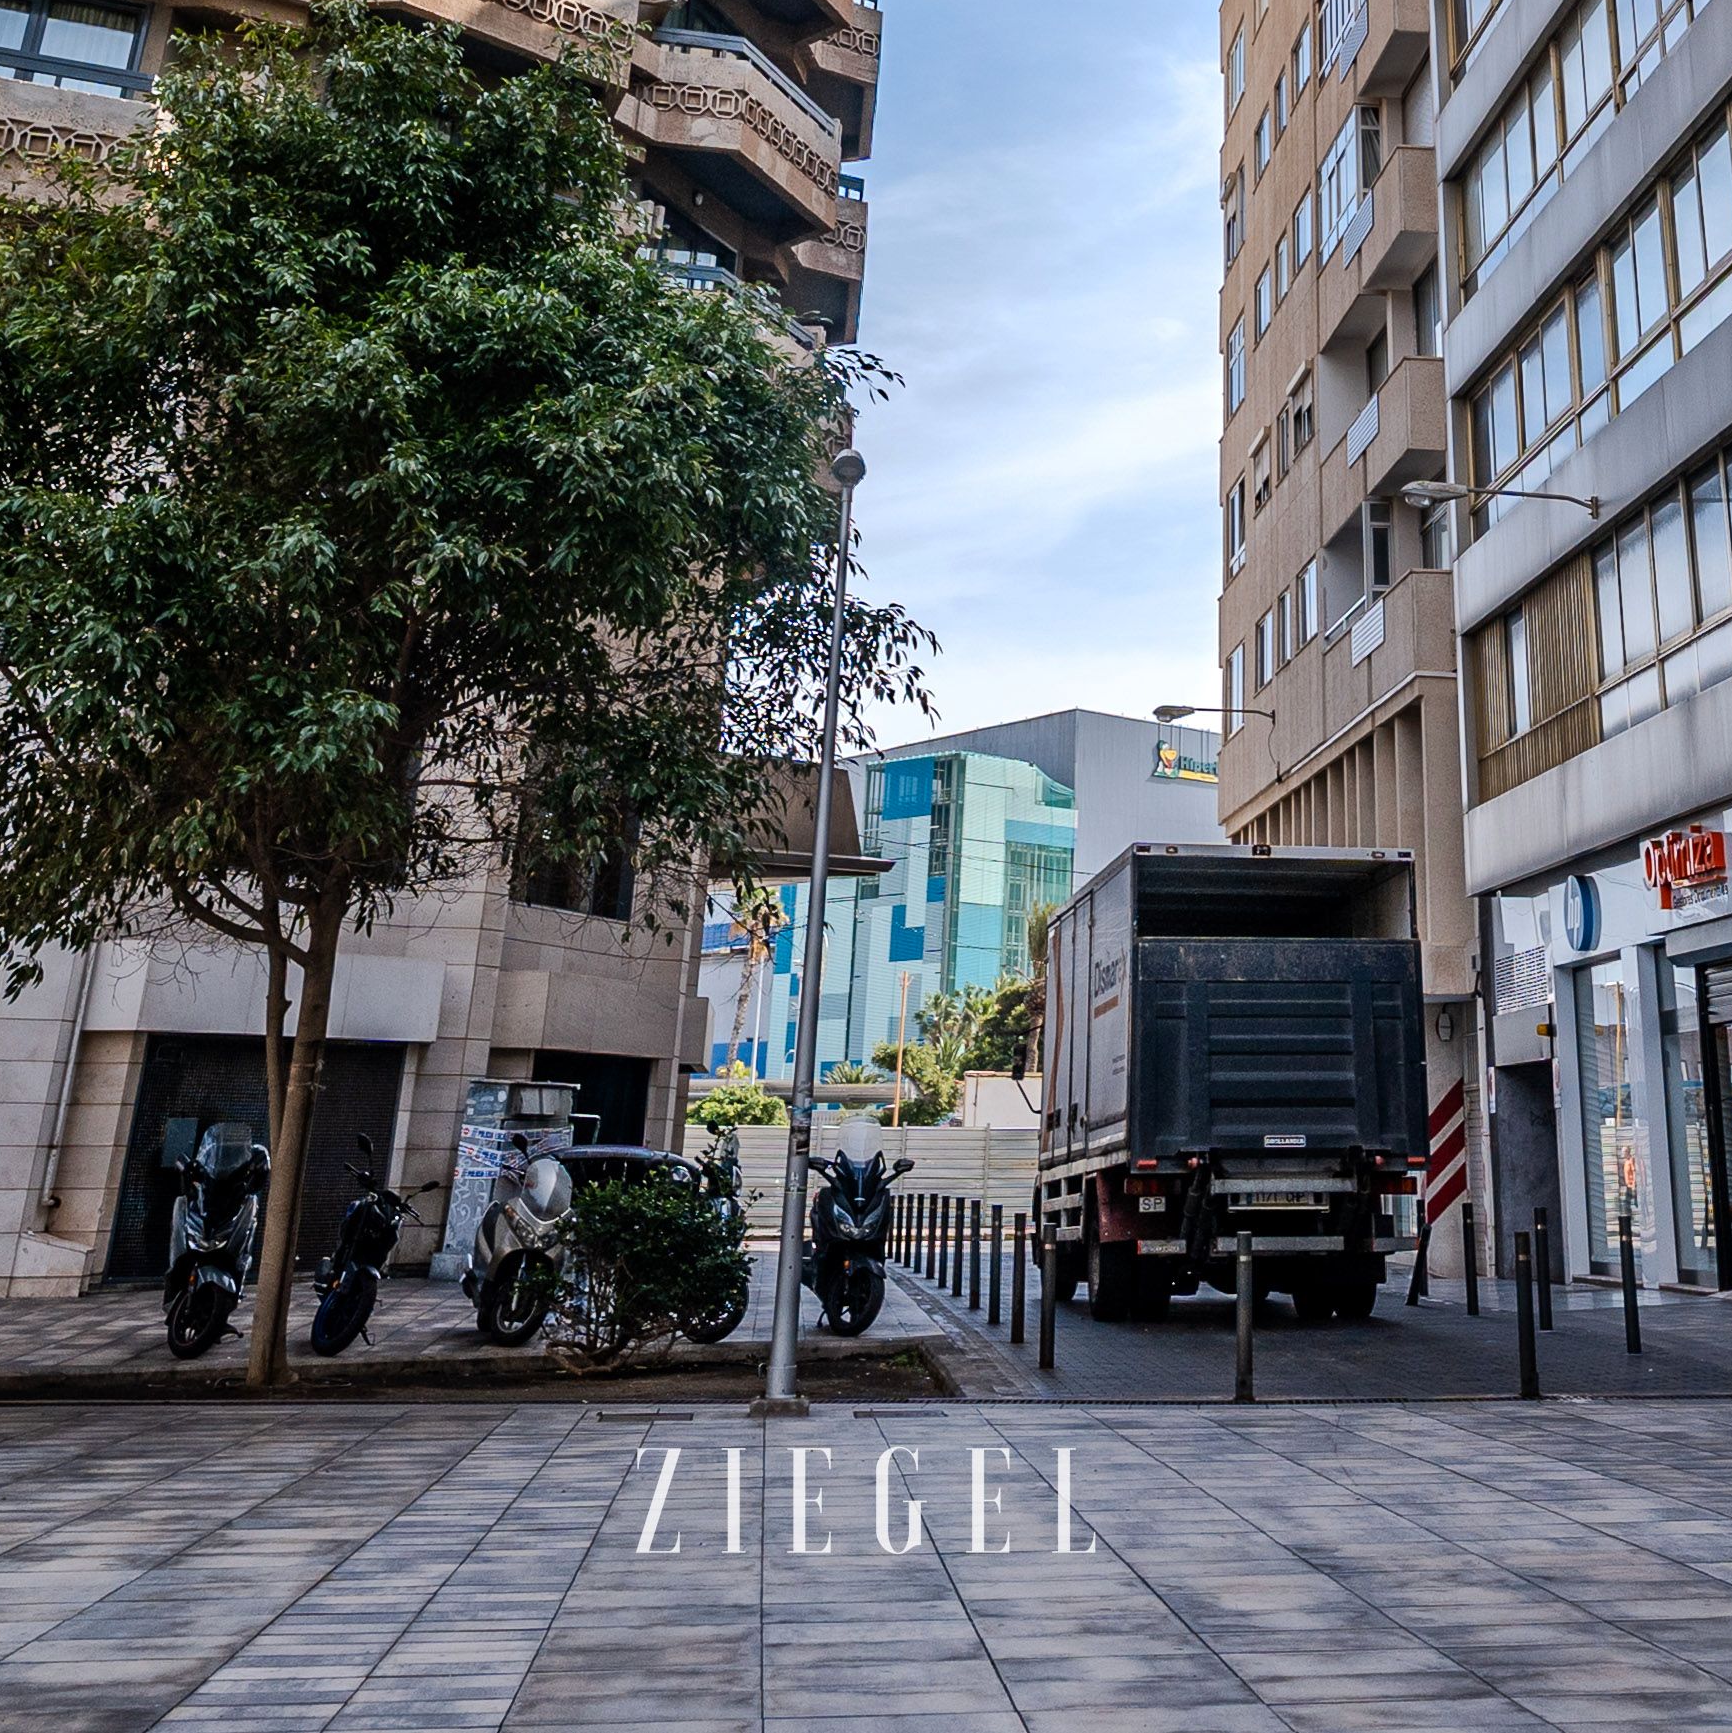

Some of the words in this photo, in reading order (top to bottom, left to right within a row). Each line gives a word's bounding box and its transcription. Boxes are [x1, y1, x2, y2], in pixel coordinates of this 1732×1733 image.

[1643, 824, 1728, 911] Optimiza
[1567, 875, 1582, 951] hp
[1141, 1198, 1163, 1211] SP
